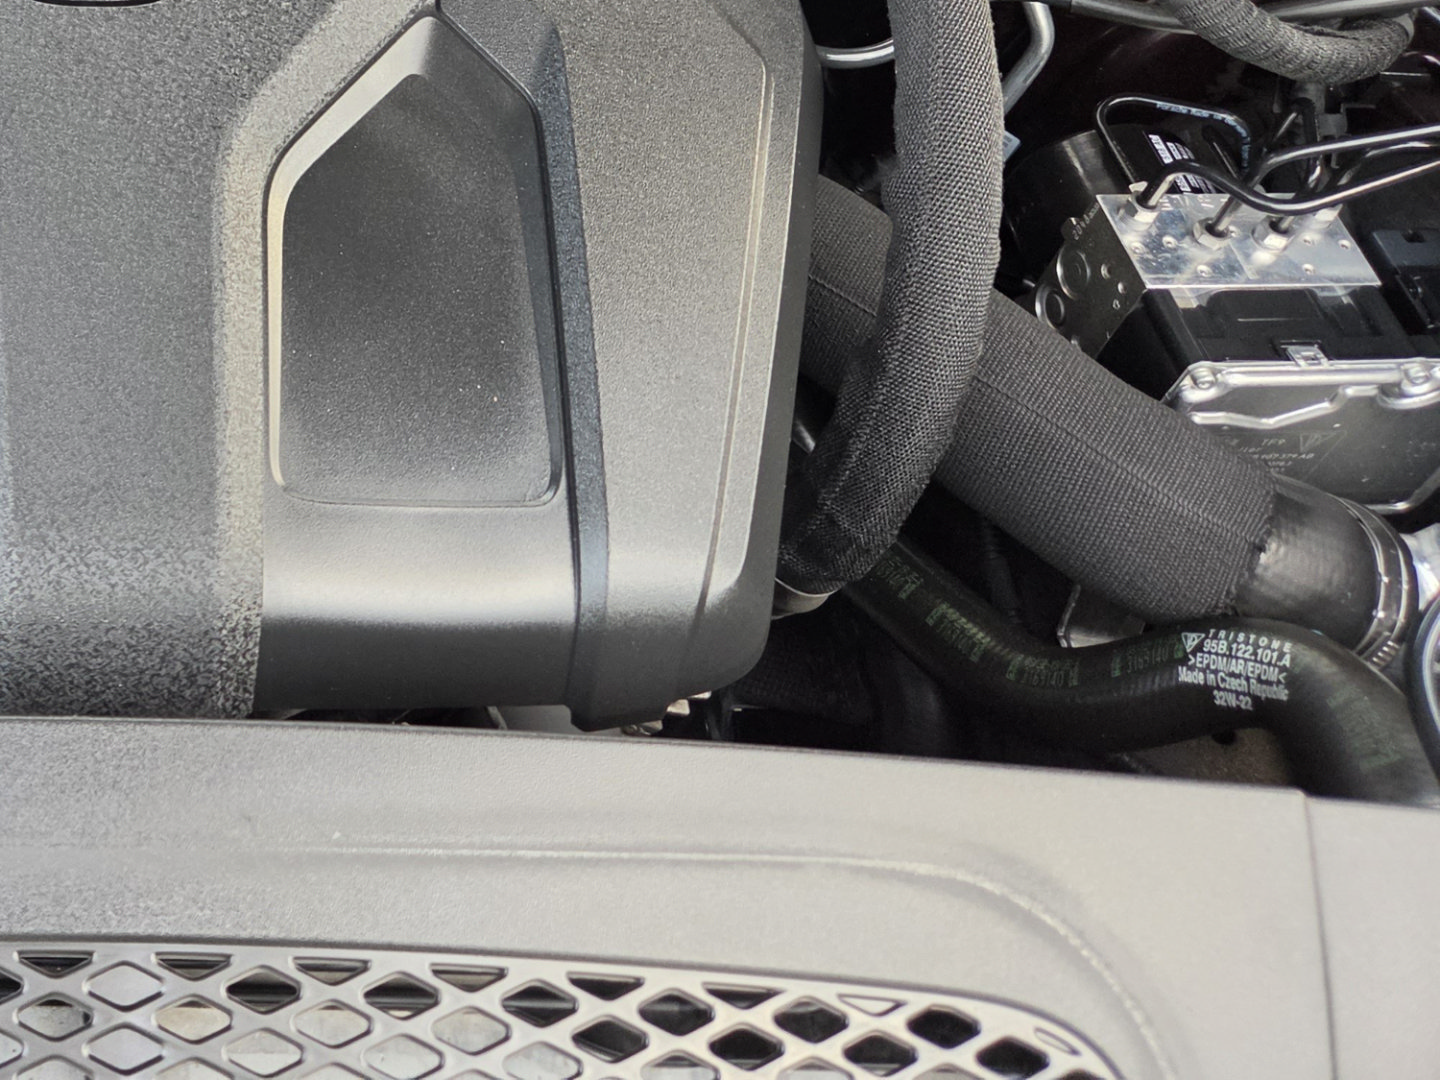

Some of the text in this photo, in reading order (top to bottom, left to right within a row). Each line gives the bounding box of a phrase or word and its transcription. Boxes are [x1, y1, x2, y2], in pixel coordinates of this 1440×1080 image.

[1202, 638, 1292, 668] 95B.122.101.A
[1208, 628, 1293, 653] TRISTONE
[1178, 665, 1290, 702] Made in Czech Republic
[1188, 652, 1288, 684] >EPDM/AR/EPDM<
